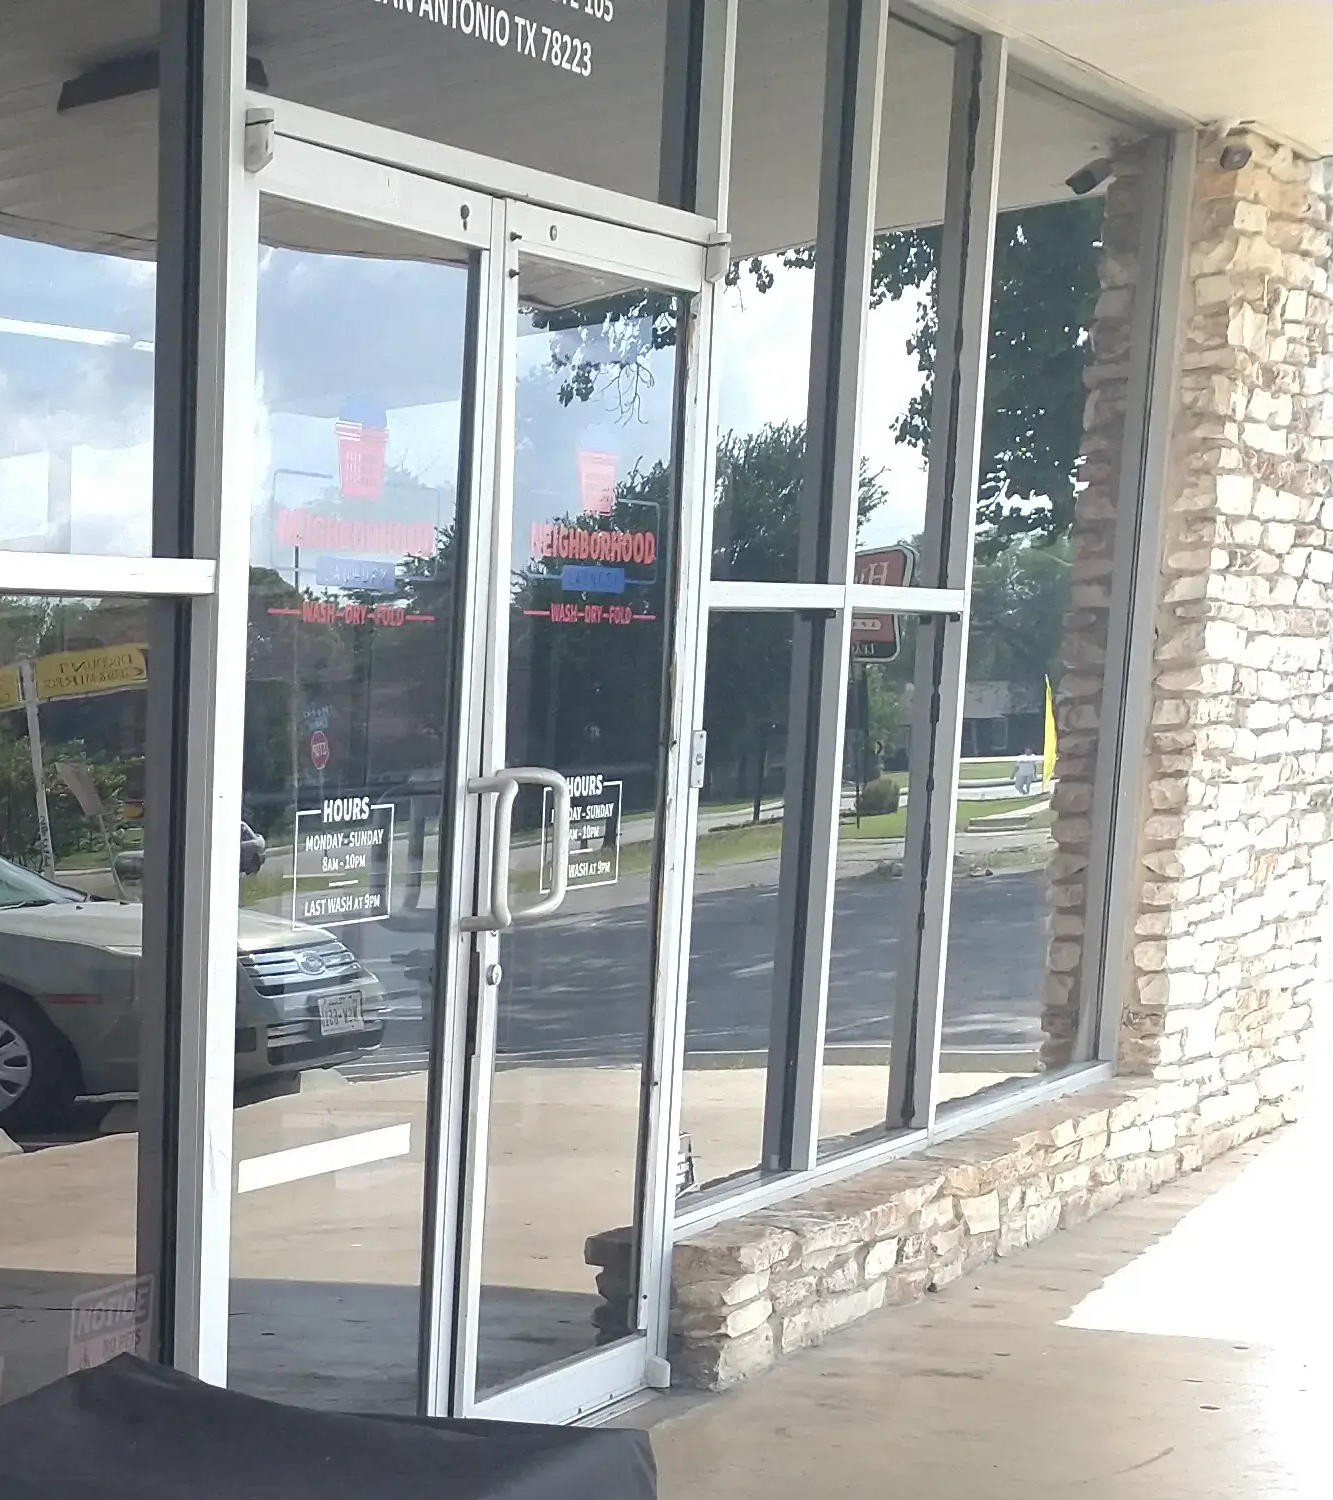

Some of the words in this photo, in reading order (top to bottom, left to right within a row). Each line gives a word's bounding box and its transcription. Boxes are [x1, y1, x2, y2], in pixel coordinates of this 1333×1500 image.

[419, 0, 510, 47] ANTONIO
[514, 15, 537, 58] TX
[541, 26, 592, 77] 78223
[530, 522, 656, 564] NEIGHBORHOOD
[566, 774, 603, 798] HOURS
[323, 797, 370, 823] HOURS
[586, 803, 614, 820] SUNDAY
[322, 856, 339, 873] 8AM
[345, 853, 366, 870] 10PM
[568, 863, 589, 878] WASH
[589, 863, 597, 875] AT
[304, 899, 326, 917] LAST
[327, 894, 353, 913] WASH
[354, 896, 364, 910] AT
[364, 893, 381, 909] 9PM
[76, 1286, 150, 1337] NOTICE
